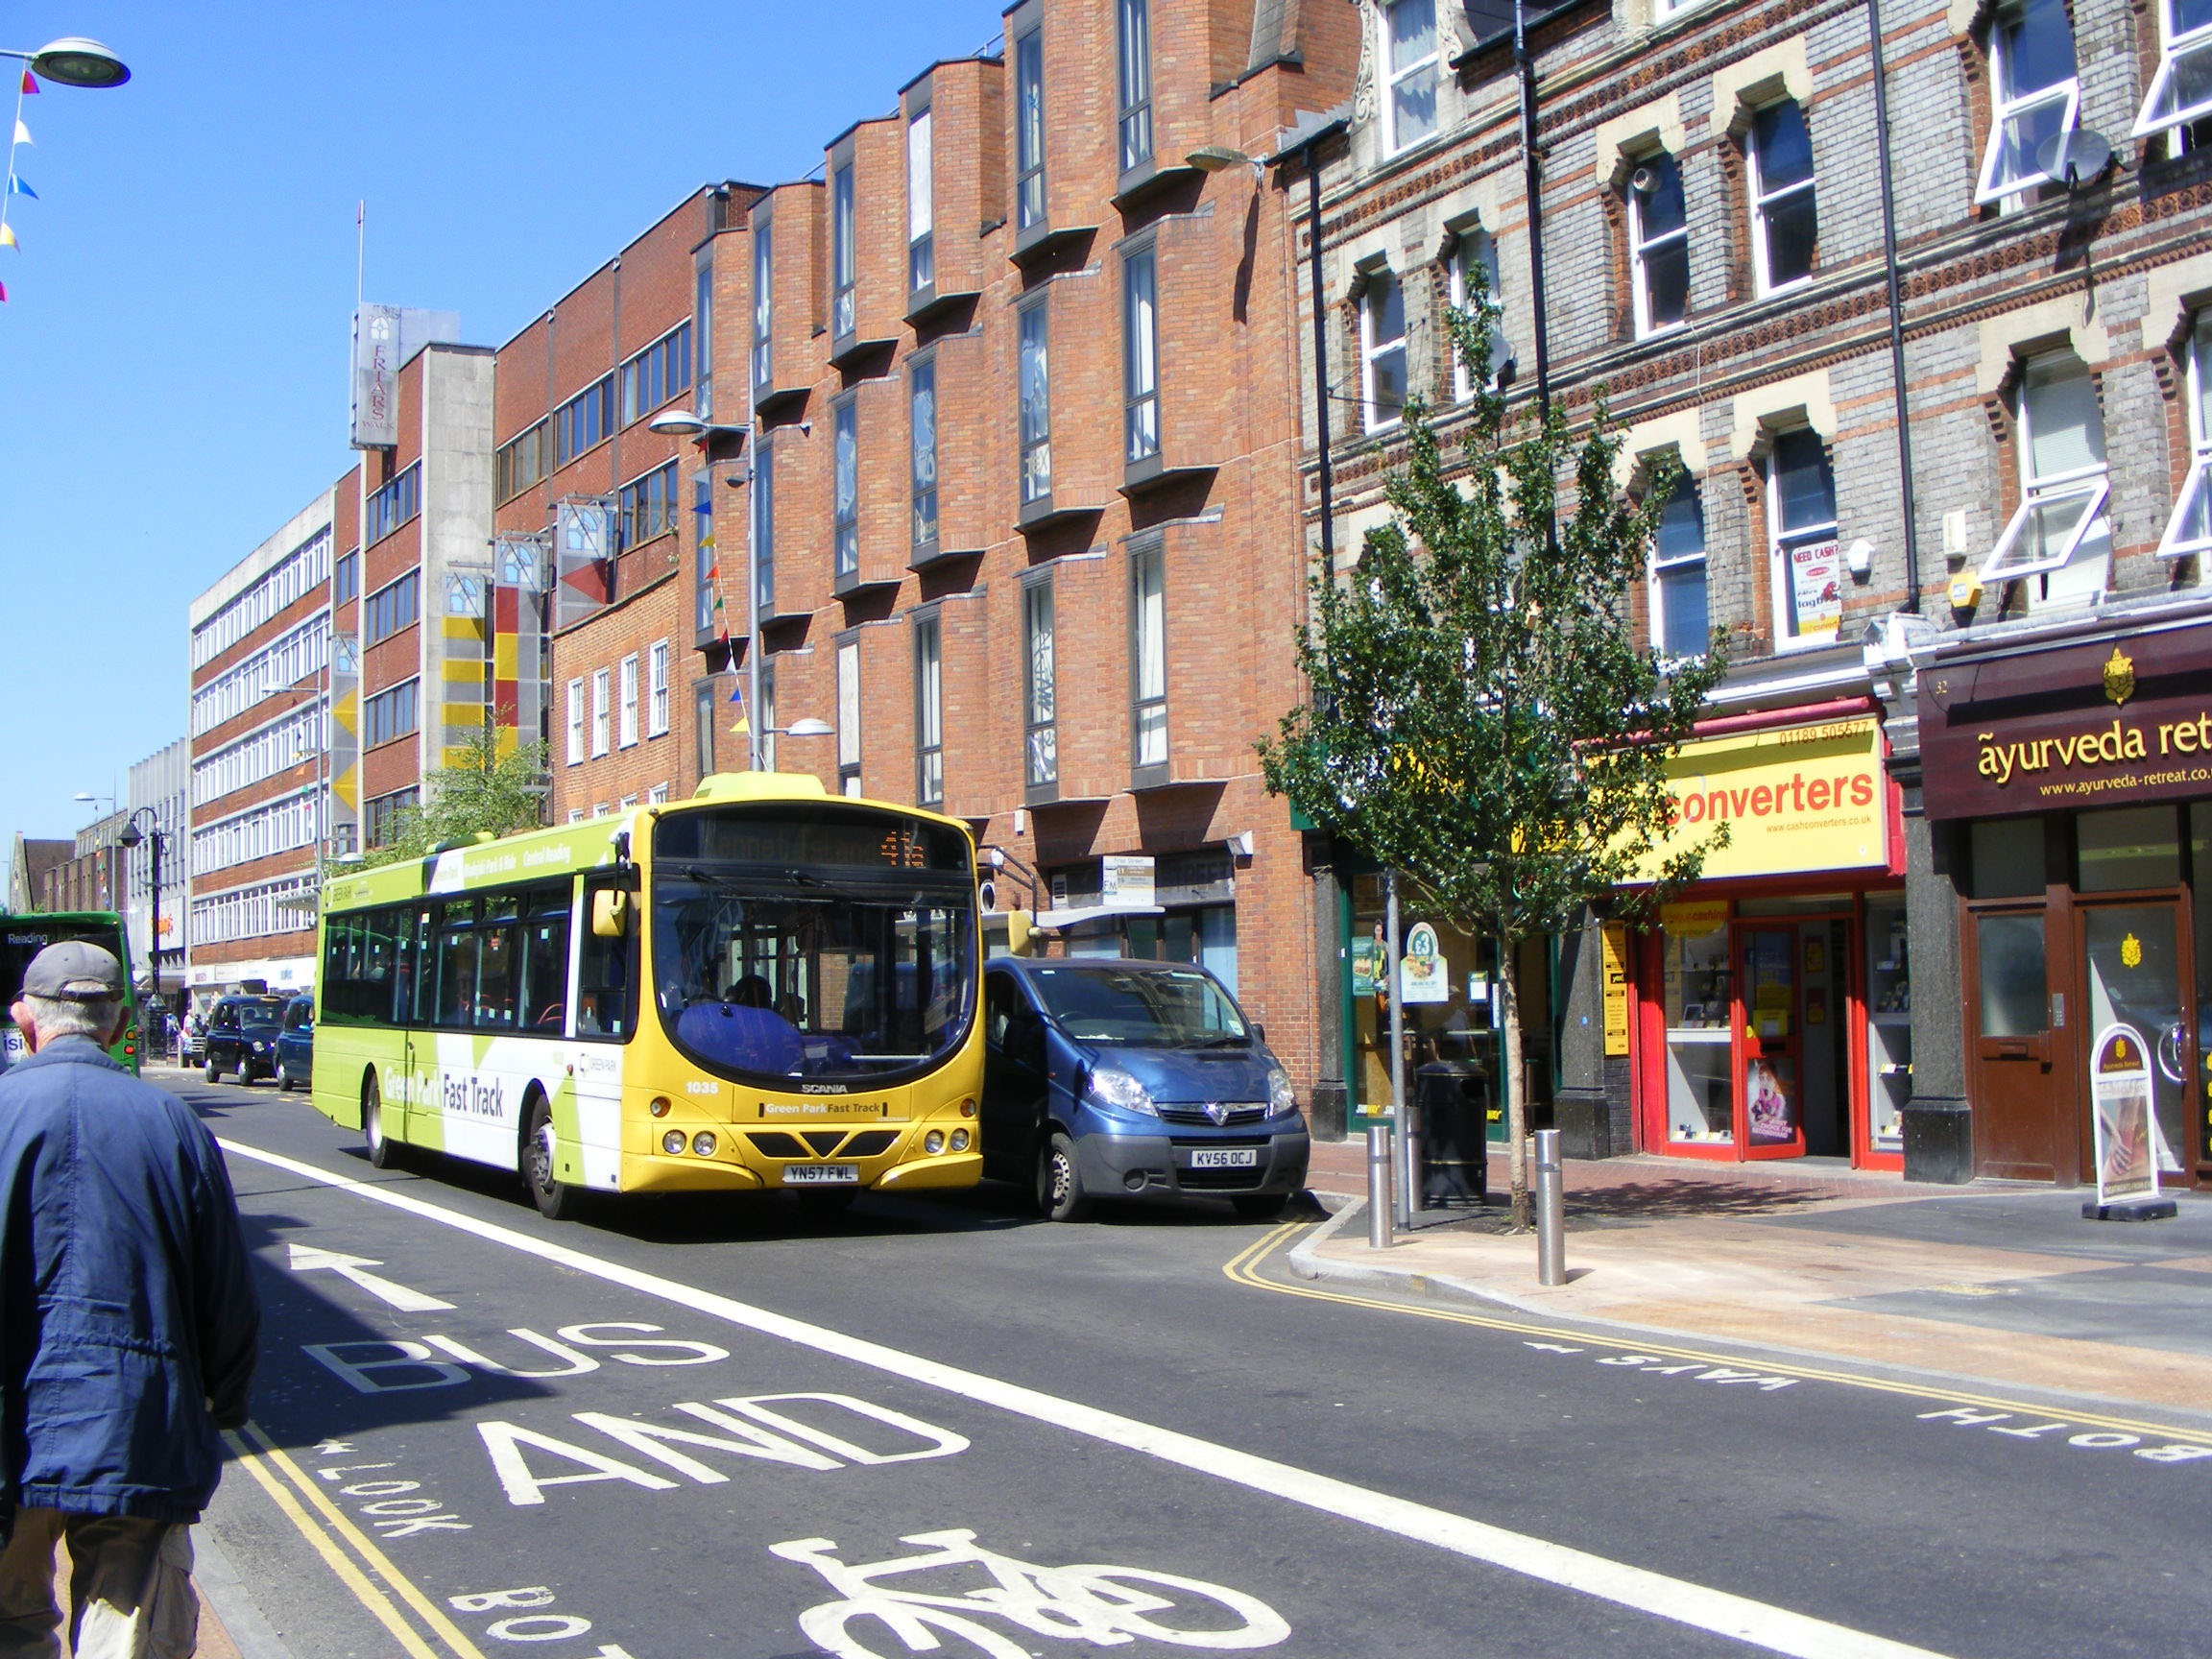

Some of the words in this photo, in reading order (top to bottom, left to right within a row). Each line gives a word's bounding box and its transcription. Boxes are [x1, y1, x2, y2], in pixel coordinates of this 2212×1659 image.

[371, 345, 386, 421] FRIARS
[362, 421, 394, 429] WALK
[1793, 550, 1812, 564] NEED
[1815, 544, 1839, 559] CASH?
[1936, 680, 1948, 694] 32
[1780, 728, 1816, 747] 01189
[1821, 721, 1868, 741] 505577
[2039, 769, 2212, 796] www.ayurveda-retreat.co.
[1664, 773, 1873, 827] converters
[1766, 813, 1872, 834] www.cashconverters.co.uk
[8, 932, 48, 946] Reading
[1414, 932, 1431, 955] £3
[384, 1065, 414, 1102] Green
[416, 1069, 443, 1107] Park
[444, 1073, 468, 1112] Fast
[470, 1077, 503, 1118] Track
[685, 1082, 718, 1094] 1035
[802, 1083, 848, 1094] SCANIA
[766, 1103, 800, 1114] Green
[803, 1103, 827, 1114] Park
[827, 1103, 850, 1114] Fast
[853, 1103, 879, 1114] Track
[1197, 1152, 1228, 1166] KV56
[1230, 1152, 1252, 1165] OCJ
[791, 1166, 825, 1181] YN57
[828, 1166, 853, 1180] FWL
[301, 1321, 731, 1394] BUS
[1597, 1354, 1800, 1391] WAYS
[1916, 1407, 2212, 1463] BOTH
[476, 1392, 972, 1506] AND
[317, 1461, 473, 1538] LOOK
